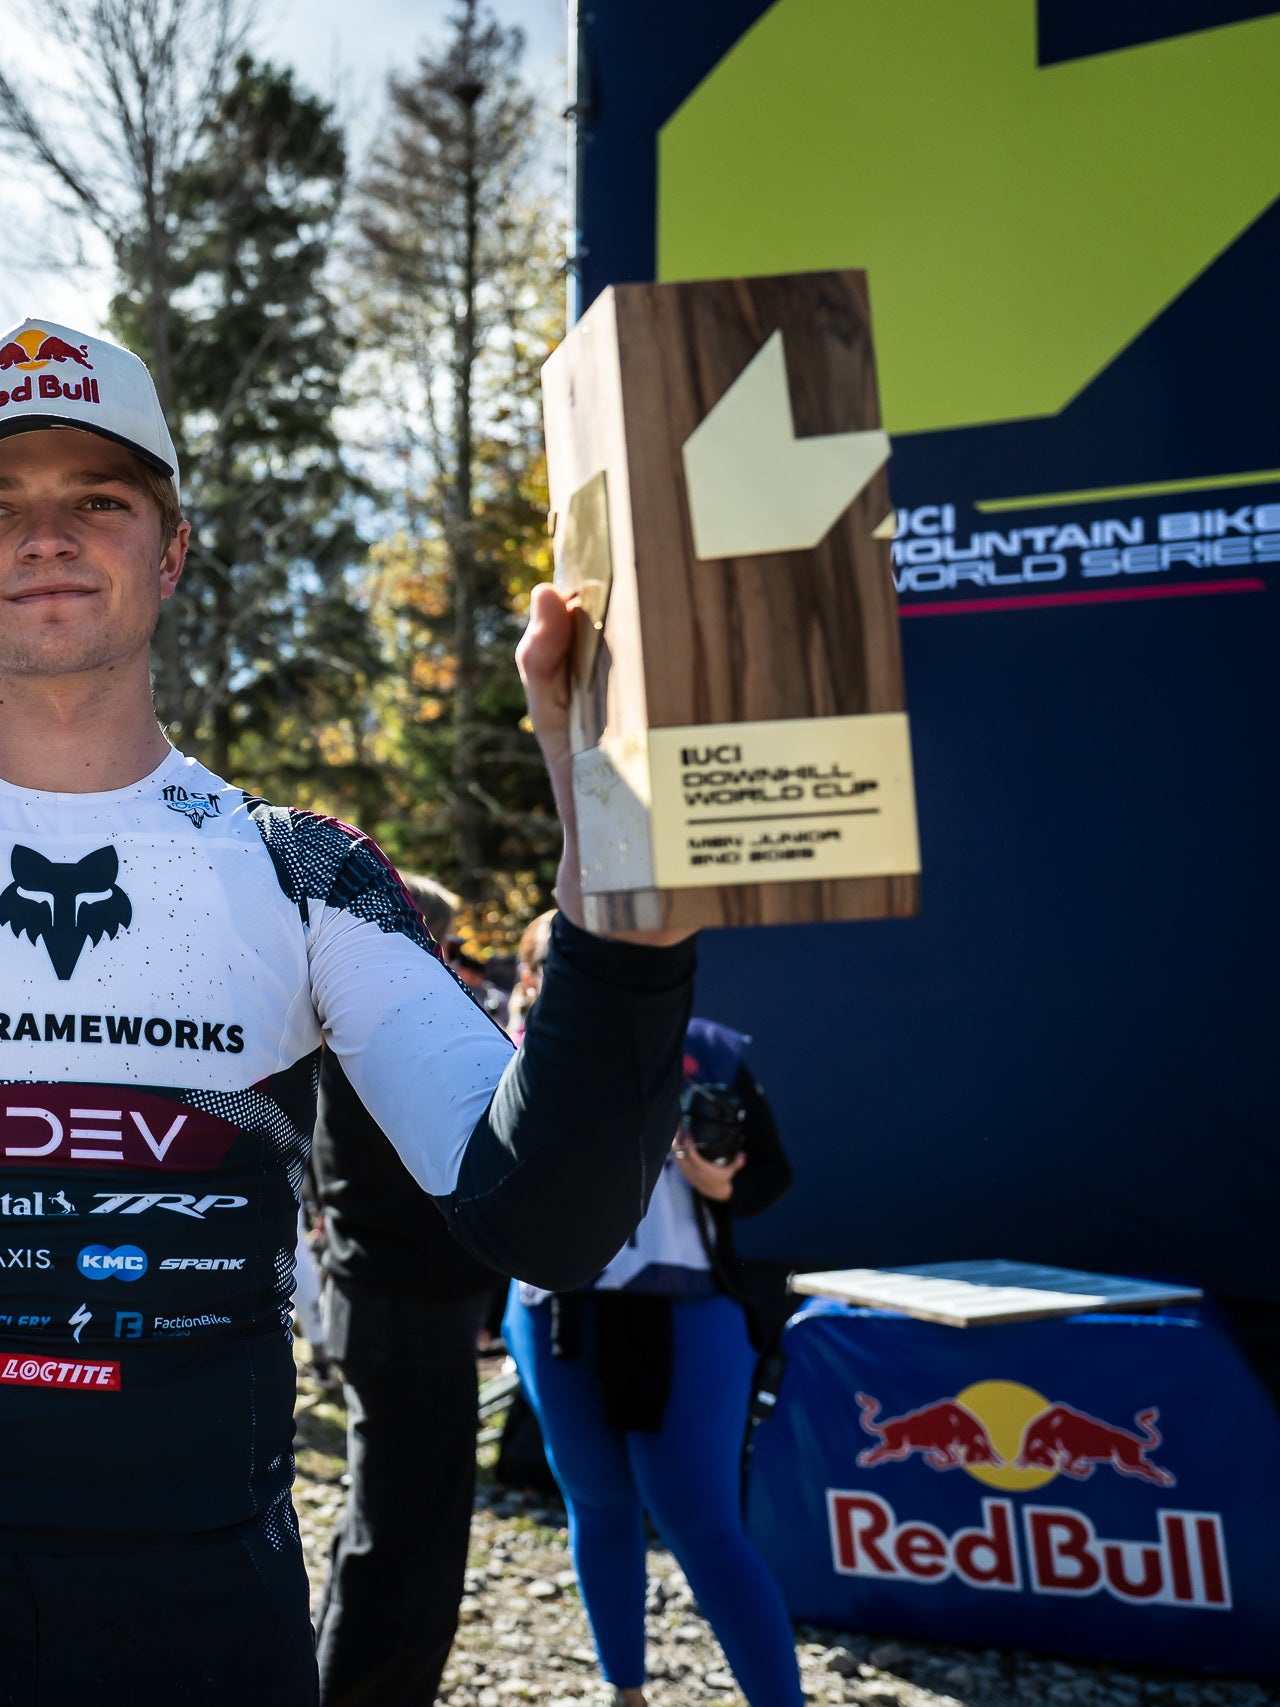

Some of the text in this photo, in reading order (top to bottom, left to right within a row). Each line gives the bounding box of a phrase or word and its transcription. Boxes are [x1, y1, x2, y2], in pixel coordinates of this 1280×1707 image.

[39, 374, 100, 404] Bull
[682, 762, 854, 788] DOWNHILL
[684, 779, 880, 807] WORLD CUP
[89, 1193, 249, 1219] TRP
[82, 1255, 144, 1270] KMC
[1, 1358, 114, 1386] LOCTITE
[827, 1489, 1233, 1610] Red Bull
